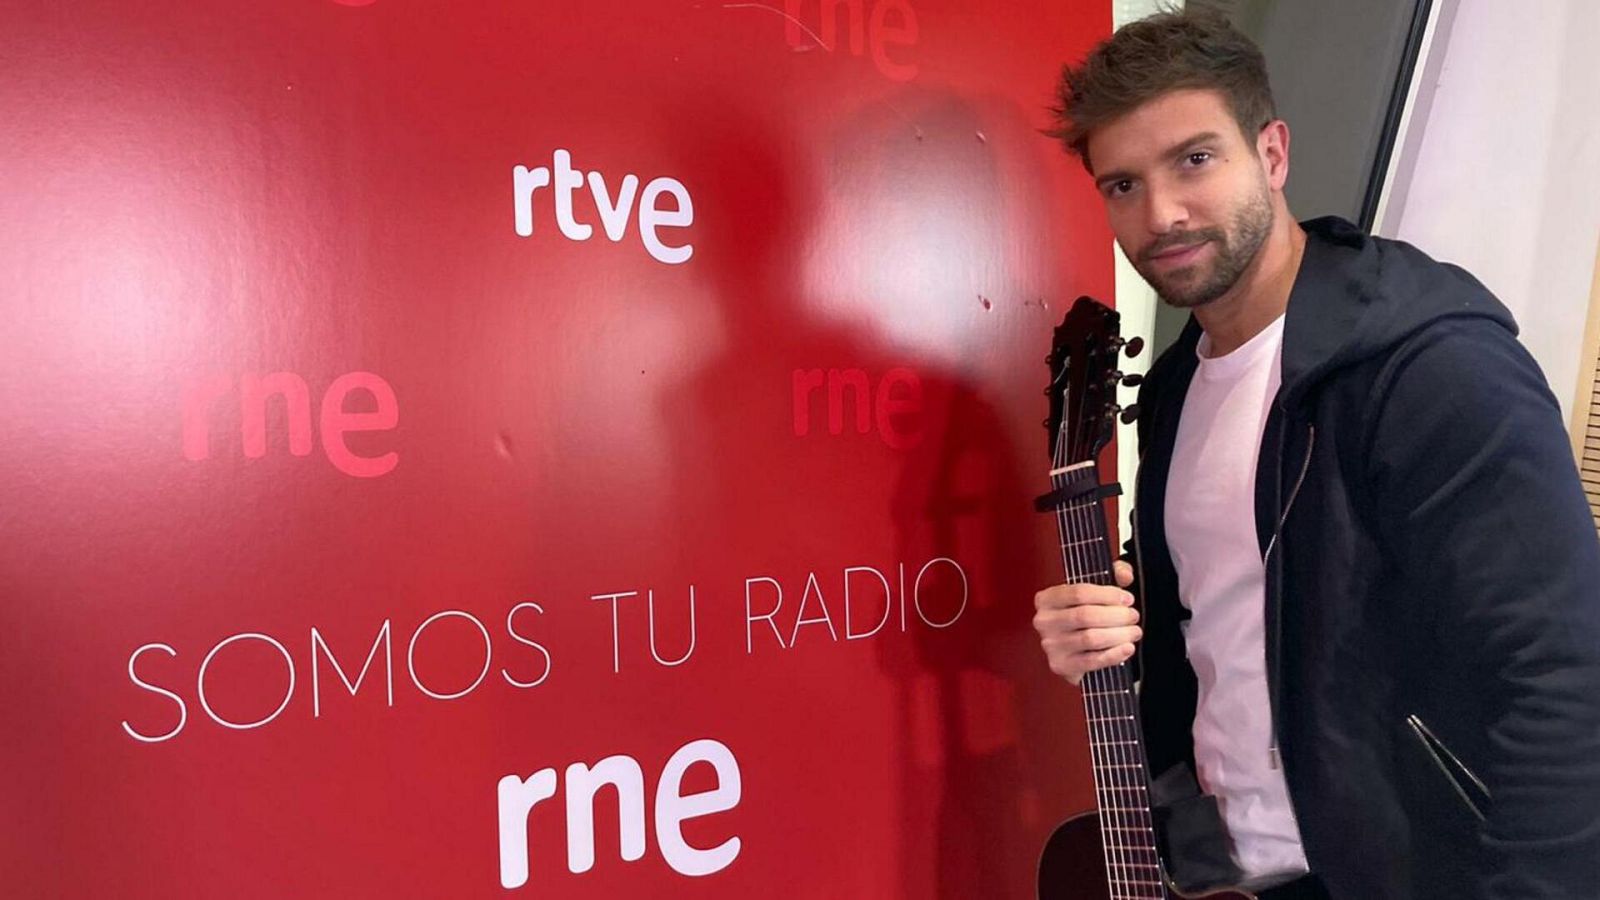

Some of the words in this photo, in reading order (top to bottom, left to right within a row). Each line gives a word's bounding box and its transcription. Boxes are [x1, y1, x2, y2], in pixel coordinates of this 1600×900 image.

[512, 148, 694, 264] rtve
[180, 370, 399, 478] rne
[792, 367, 923, 449] rne
[121, 601, 551, 743] SOMOS
[590, 584, 697, 674] TU
[745, 557, 968, 654] RADIO
[497, 739, 742, 889] rne
